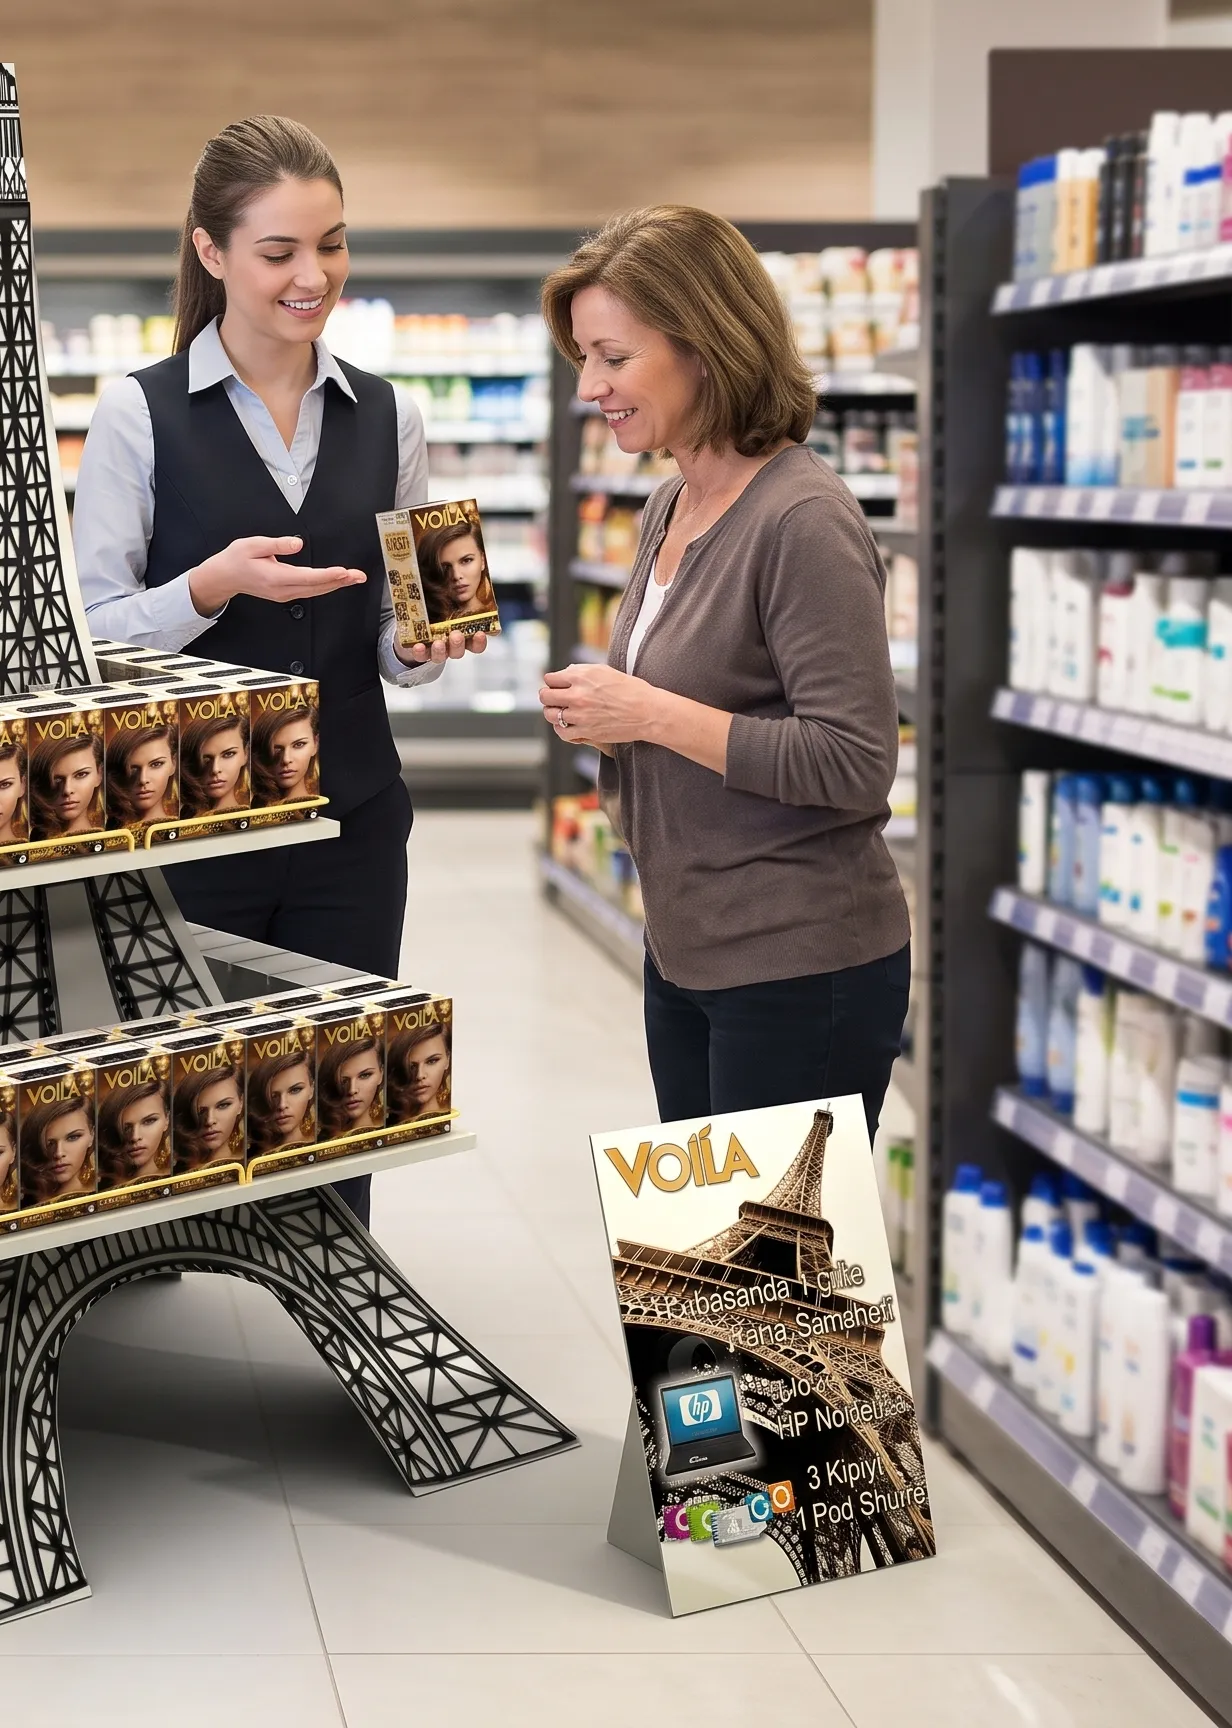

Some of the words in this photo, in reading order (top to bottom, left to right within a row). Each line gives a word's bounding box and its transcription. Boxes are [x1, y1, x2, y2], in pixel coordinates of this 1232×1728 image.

[185, 700, 237, 720] VOILA
[256, 691, 307, 712] VOILA
[34, 718, 89, 740] VOILA
[111, 710, 165, 731] VOILA
[393, 1009, 440, 1031] VOILA
[323, 1020, 373, 1046] VOILA
[179, 1048, 232, 1074] VOILA
[254, 1037, 303, 1060] VOILA
[104, 1064, 157, 1090] VOILA
[26, 1080, 81, 1106] VOILA
[778, 1411, 808, 1440] HP
[807, 1465, 821, 1490] 3
[796, 1506, 807, 1531] 1
[812, 1495, 854, 1528] Pod
[859, 1486, 926, 1516] Shurre
